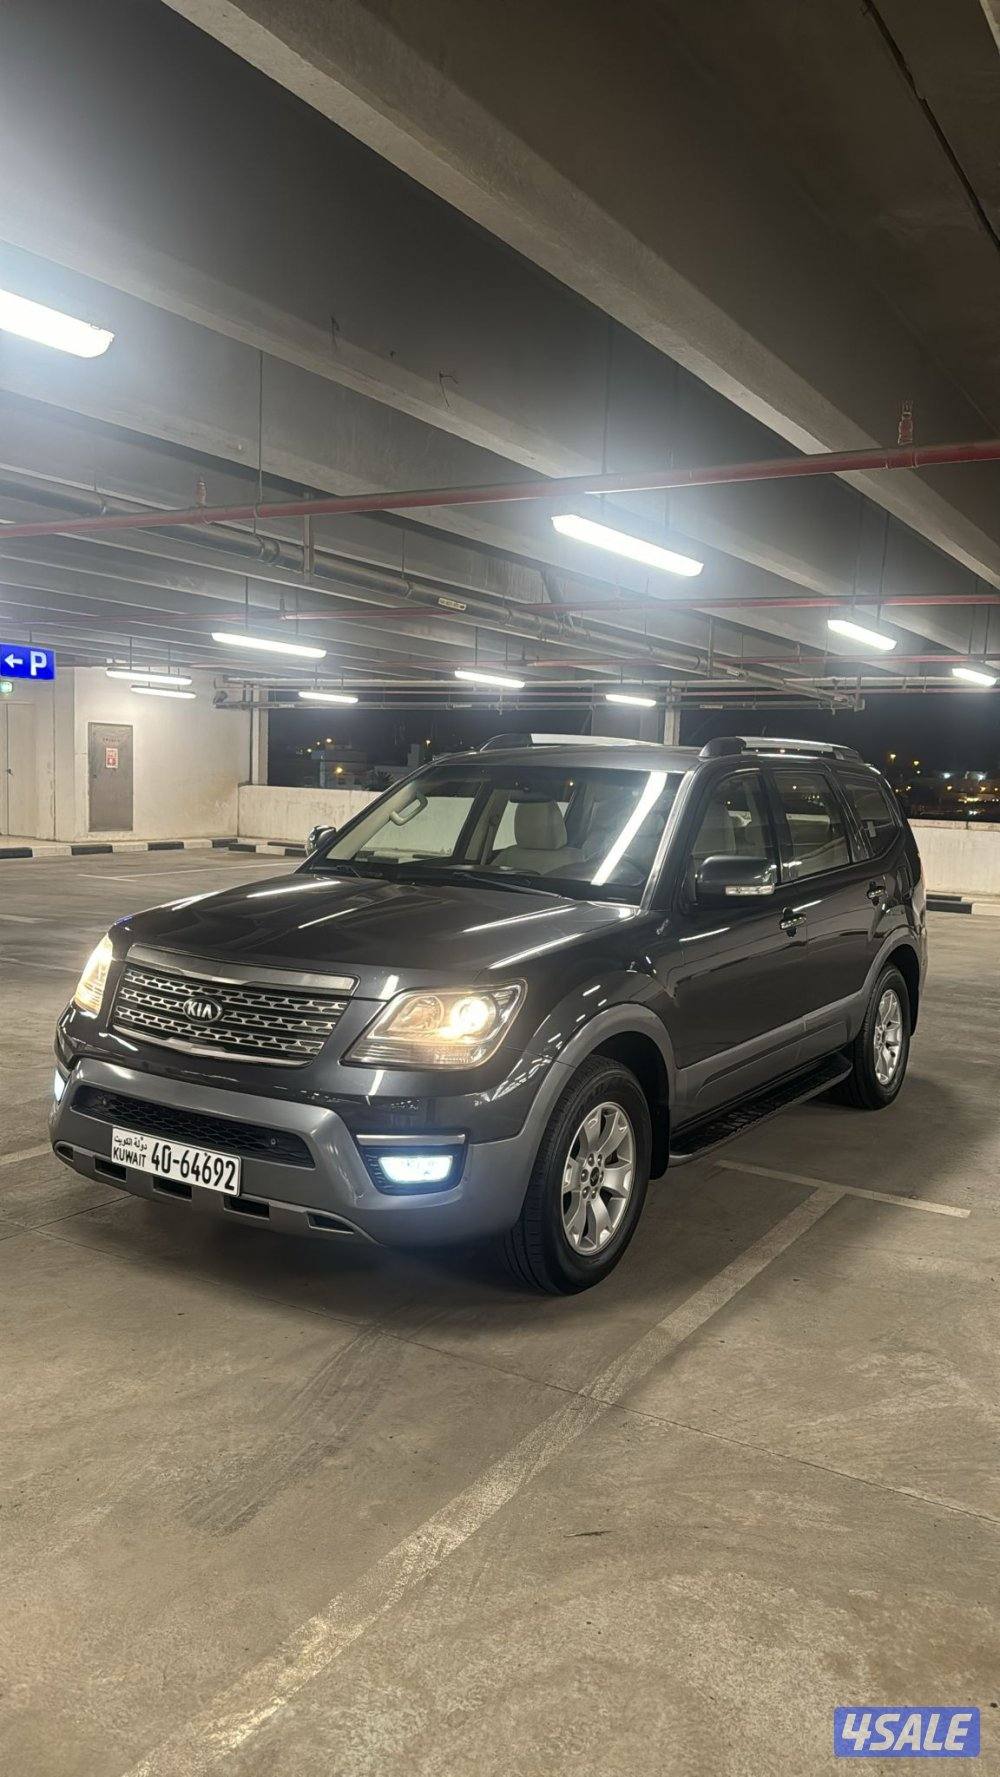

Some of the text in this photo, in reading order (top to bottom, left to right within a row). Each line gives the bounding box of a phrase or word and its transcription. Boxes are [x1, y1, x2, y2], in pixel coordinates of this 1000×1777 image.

[31, 651, 47, 676] P
[187, 1001, 212, 1018] KIA
[113, 1136, 148, 1151] دولة الكويت
[113, 1146, 146, 1167] KUWAIT
[151, 1142, 236, 1191] 40-64692
